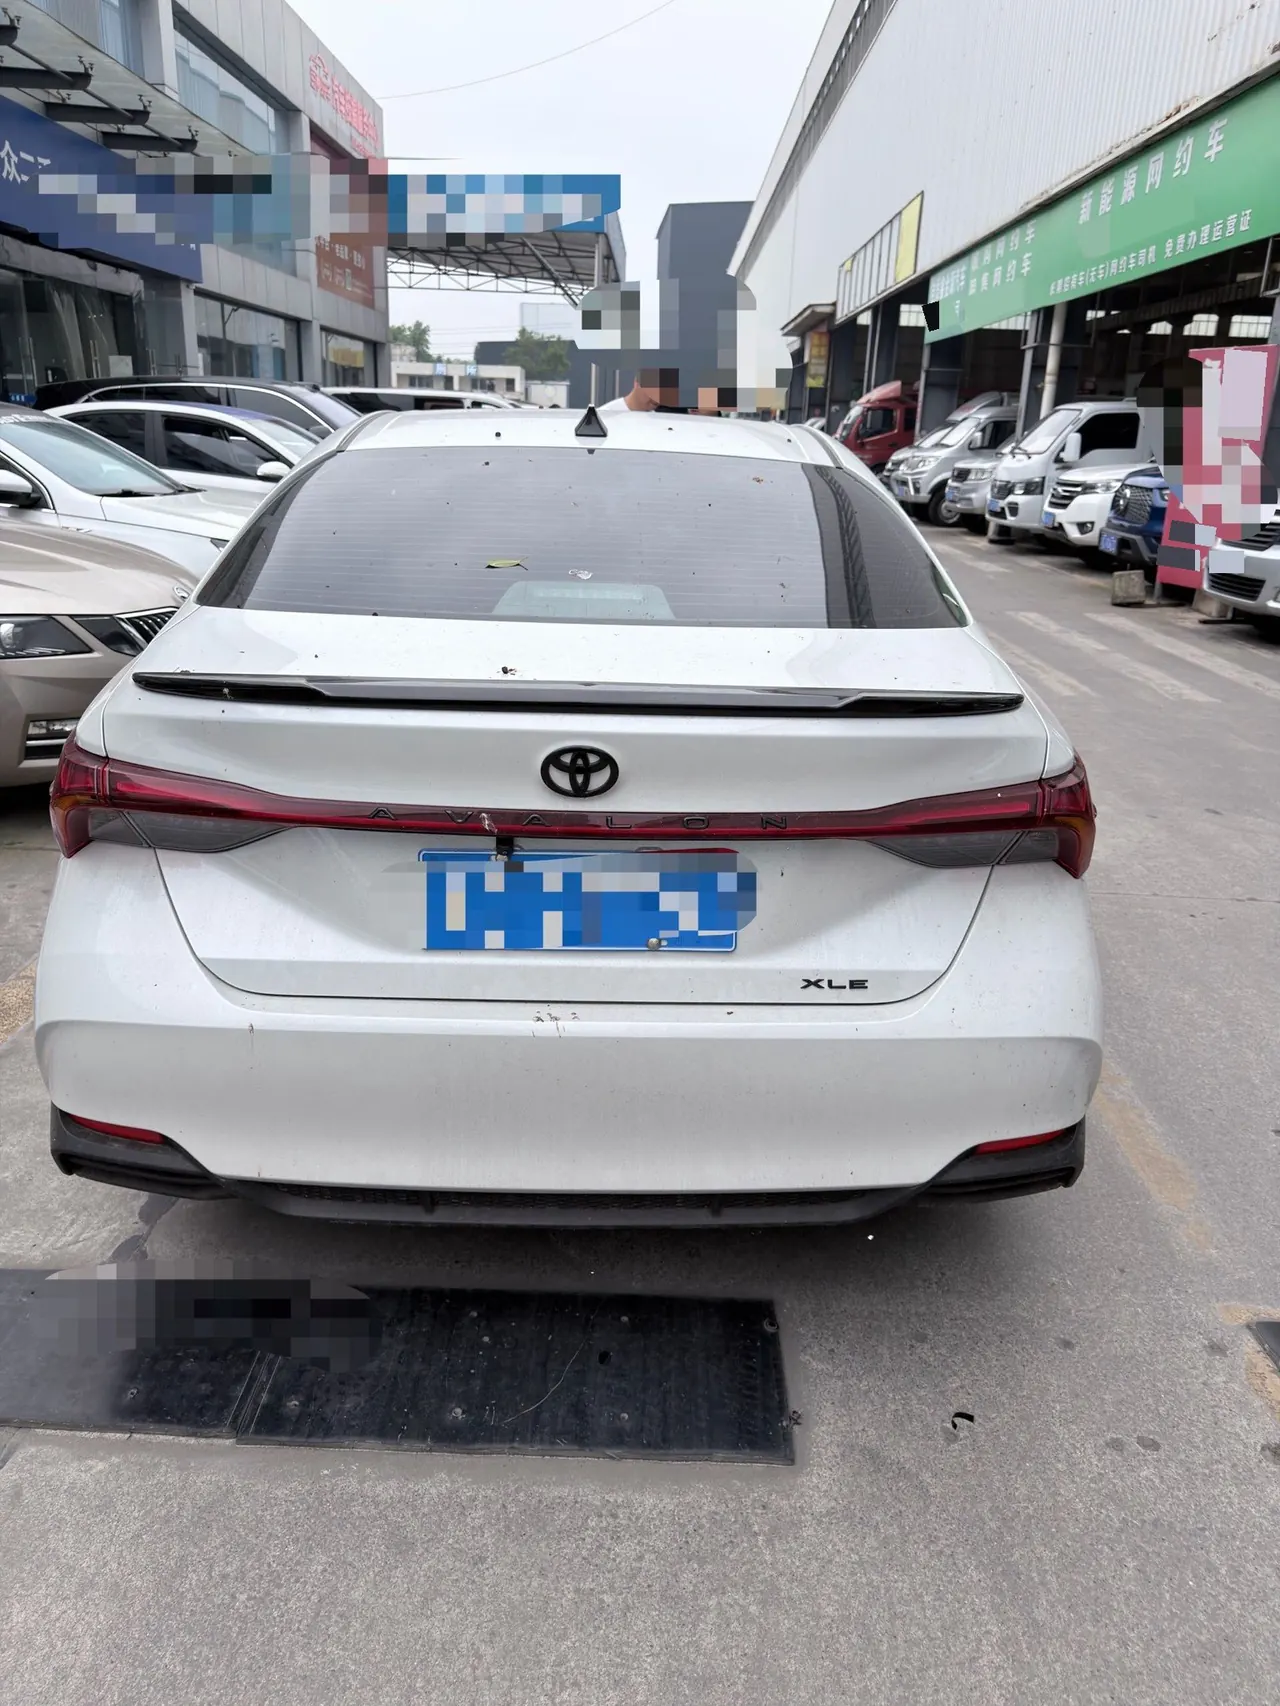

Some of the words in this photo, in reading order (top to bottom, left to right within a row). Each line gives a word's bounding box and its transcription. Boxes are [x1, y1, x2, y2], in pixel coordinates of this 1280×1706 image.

[1078, 118, 1228, 225] 新能源网约车
[1164, 209, 1253, 259] 免费办理运营证
[367, 806, 788, 831] AVALON
[800, 979, 869, 990] XLE
